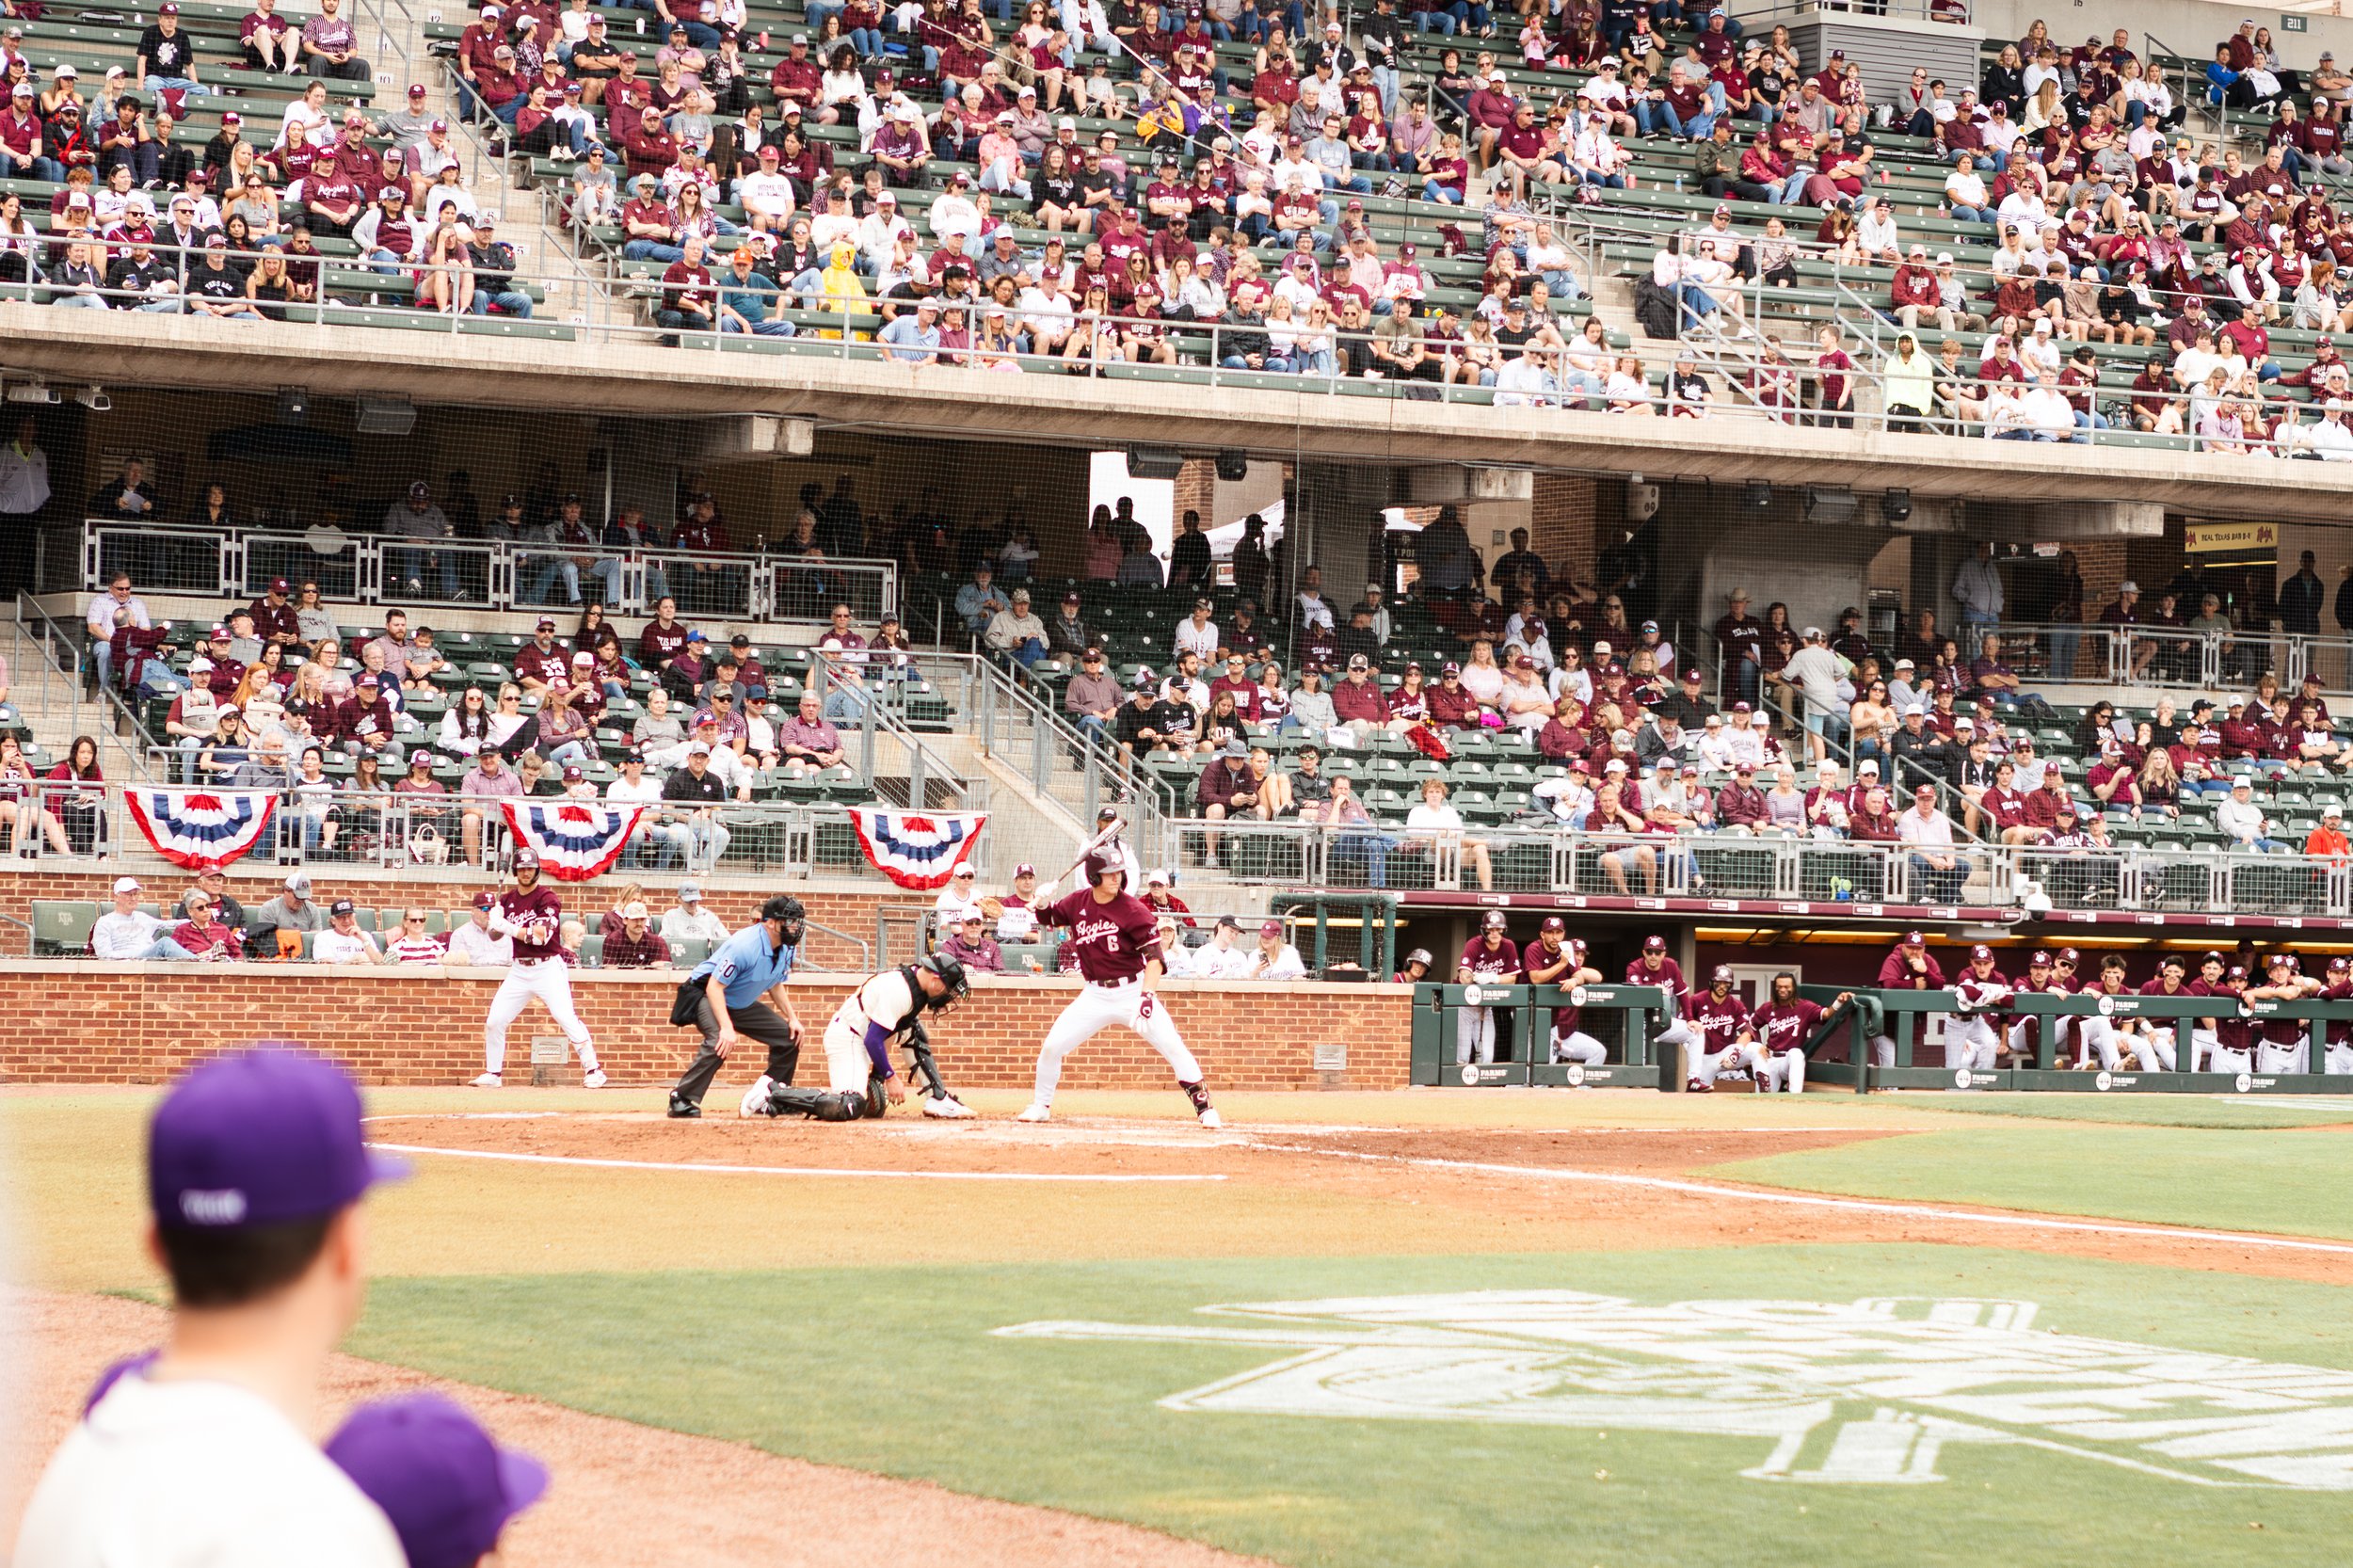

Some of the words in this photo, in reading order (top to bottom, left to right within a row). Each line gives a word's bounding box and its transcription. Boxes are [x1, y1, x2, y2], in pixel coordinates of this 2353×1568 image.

[2287, 18, 2301, 29] 211
[1631, 40, 1653, 55] 12
[317, 184, 349, 199] Aggies
[485, 893, 493, 903] T
[1076, 919, 1119, 944] Aggies
[1107, 935, 1120, 952] 6
[1482, 989, 1510, 998] FARMS
[1588, 991, 1614, 1000] FARMS
[2115, 1000, 2139, 1009] FARMS
[2255, 1002, 2278, 1011] FARMS
[1700, 1014, 1735, 1030] Aggies
[1769, 1015, 1801, 1033] Aggies
[1723, 1025, 1732, 1036] 8
[1480, 1069, 1507, 1078] FARMS
[2112, 1076, 2137, 1084] FARMS
[2251, 1078, 2276, 1086] FARMS
